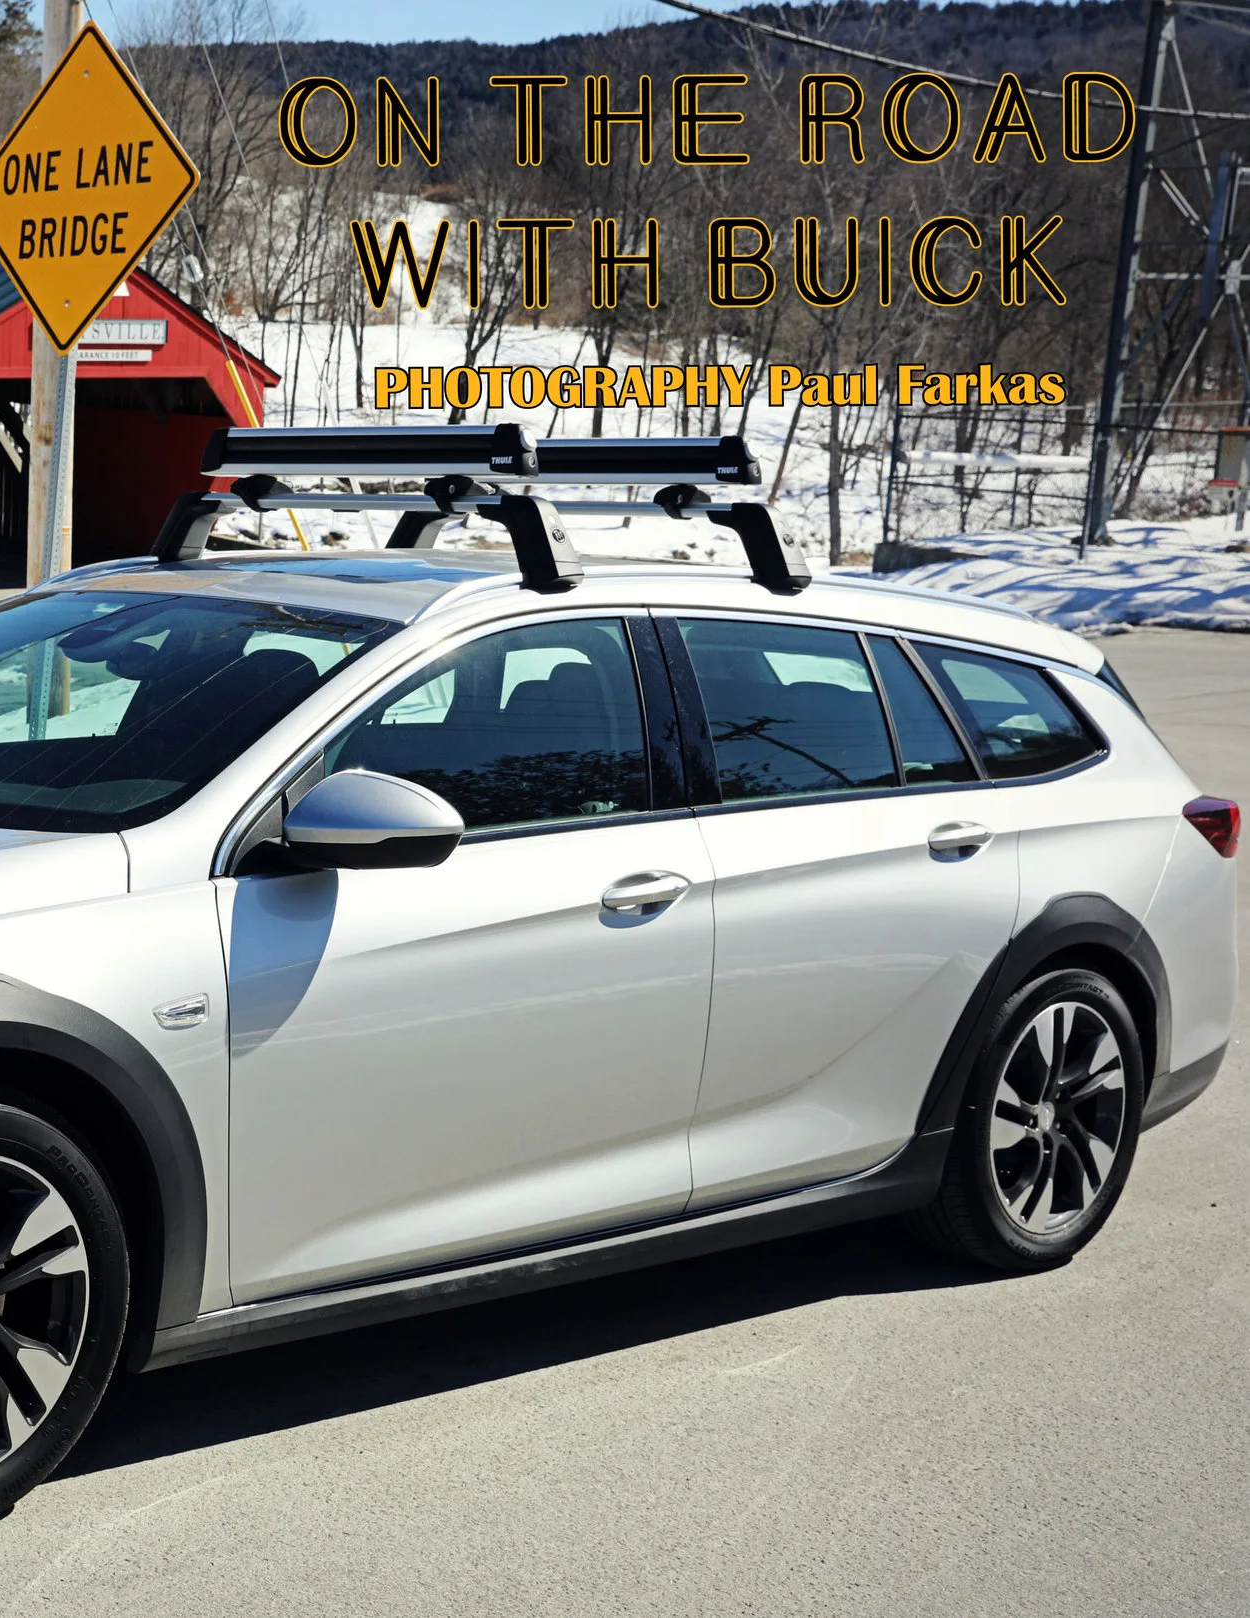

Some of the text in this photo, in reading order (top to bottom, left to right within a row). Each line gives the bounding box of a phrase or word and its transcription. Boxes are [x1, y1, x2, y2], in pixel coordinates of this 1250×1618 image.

[3, 141, 154, 196] ONE LANE
[19, 212, 129, 259] BRIDGE
[79, 351, 109, 359] ARANCE
[121, 351, 139, 359] FEET
[491, 456, 513, 465] THULE
[717, 466, 739, 475] THULE
